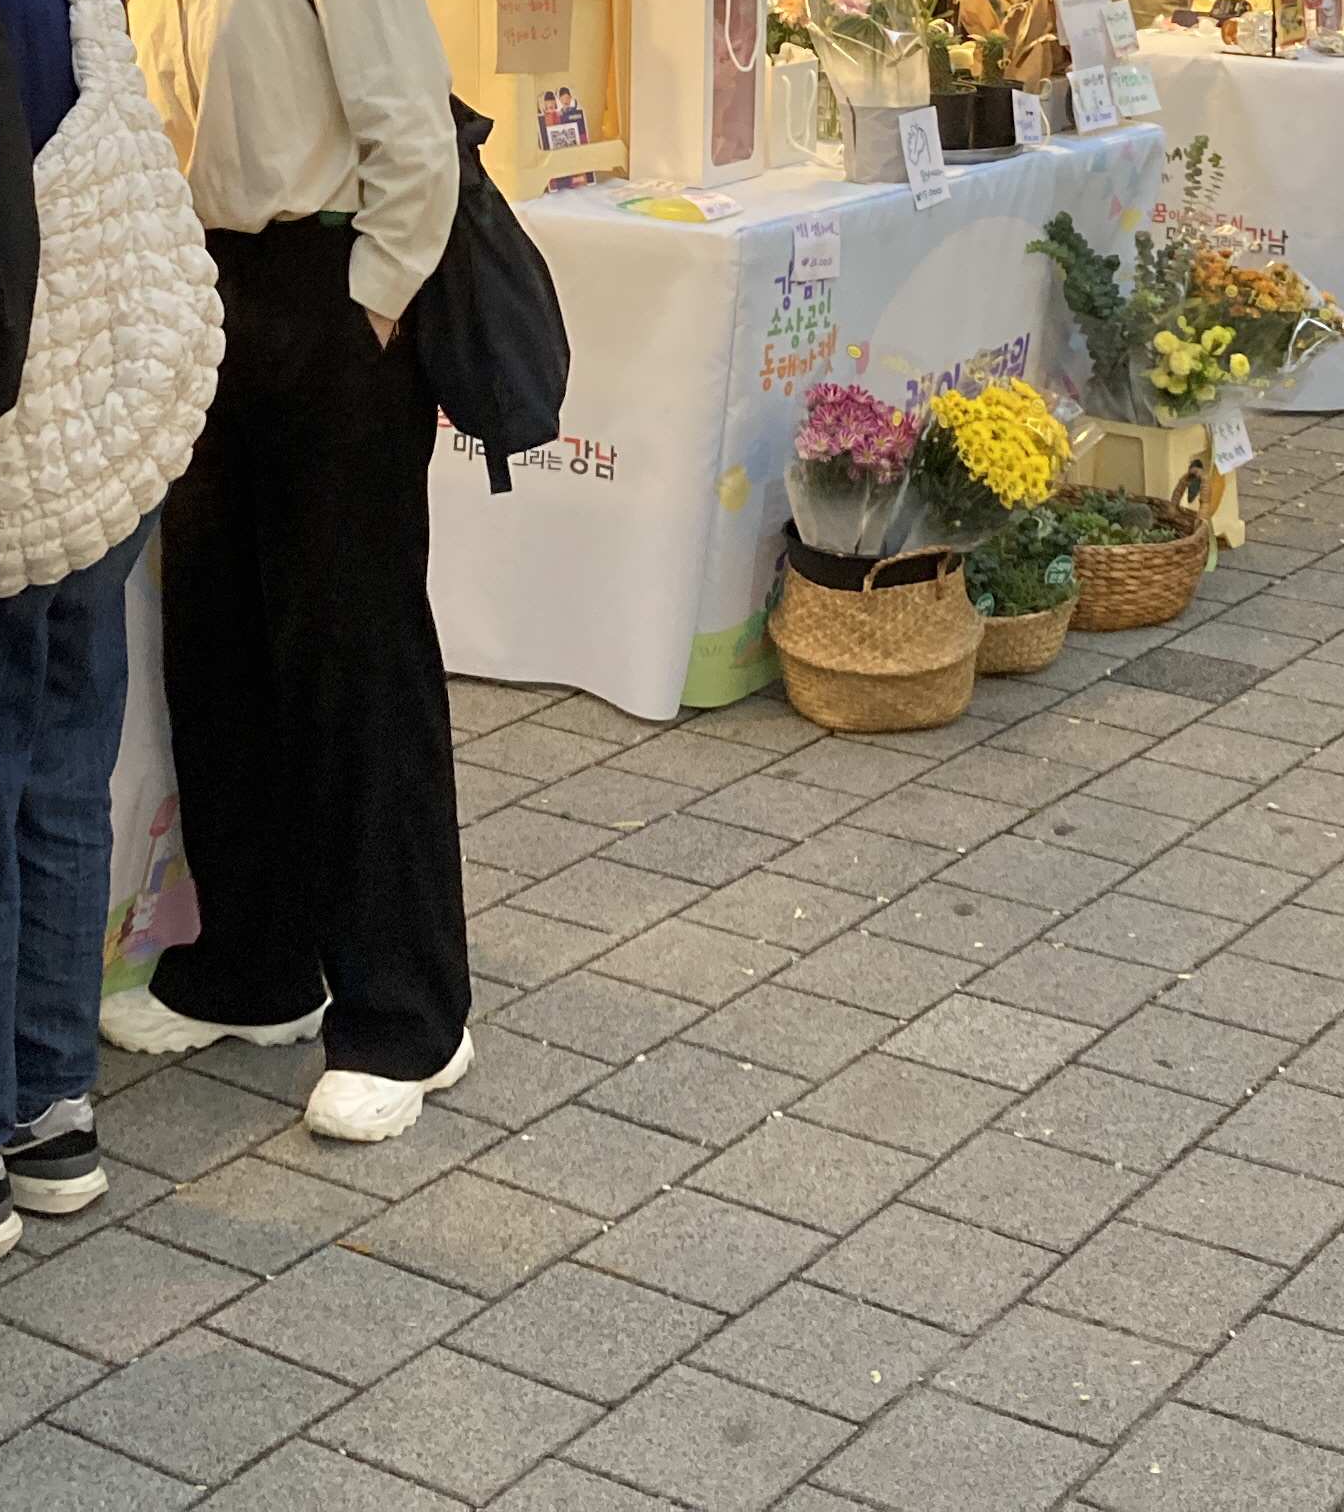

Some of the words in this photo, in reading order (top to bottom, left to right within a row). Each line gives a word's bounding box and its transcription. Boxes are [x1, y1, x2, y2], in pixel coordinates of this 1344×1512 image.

[1244, 226, 1289, 256] 강남
[767, 287, 832, 349] 소상공인
[564, 436, 618, 481] 강남
